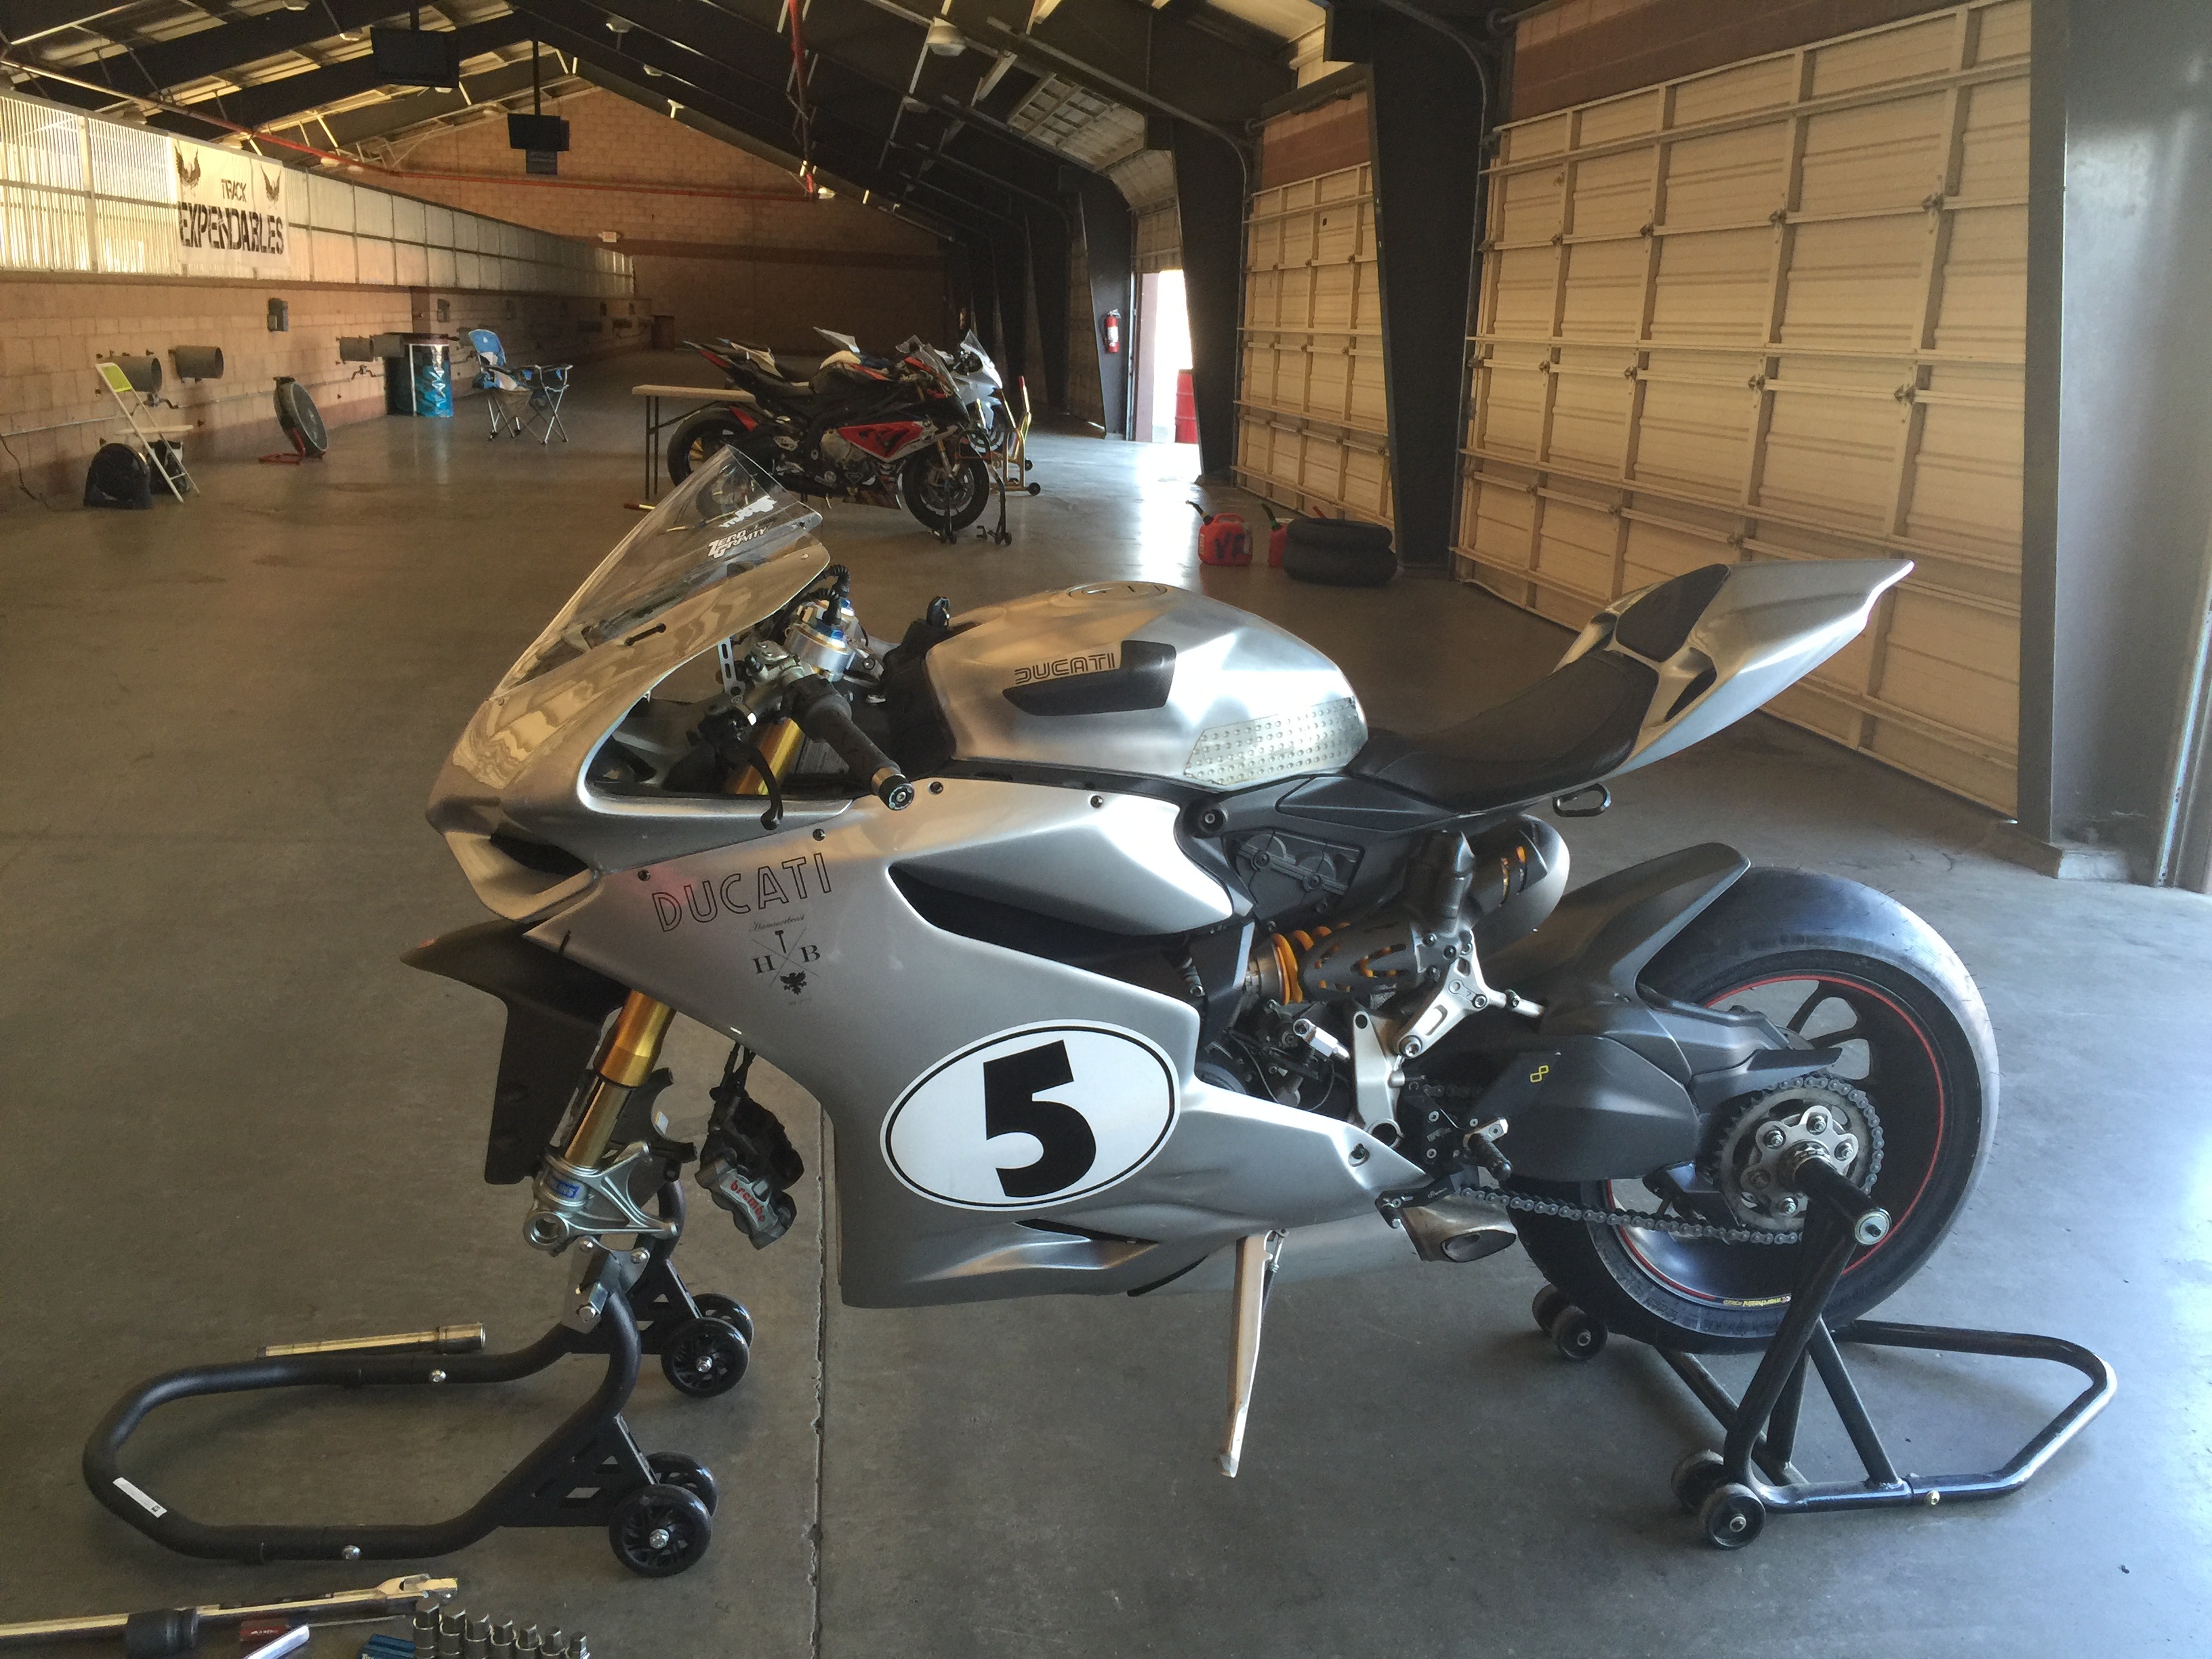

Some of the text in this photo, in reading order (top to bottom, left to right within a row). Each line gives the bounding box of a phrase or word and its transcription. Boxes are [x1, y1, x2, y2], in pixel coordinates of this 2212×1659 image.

[221, 178, 247, 203] TRACK
[178, 201, 285, 255] EXPENDABLES
[708, 529, 747, 557] ZERO
[713, 527, 767, 559] GRAVITY
[1014, 653, 1115, 684] DUCATI
[651, 852, 832, 933] DUCATI
[752, 945, 821, 975] H B
[983, 1039, 1097, 1198] 5
[730, 1179, 766, 1223] brembo
